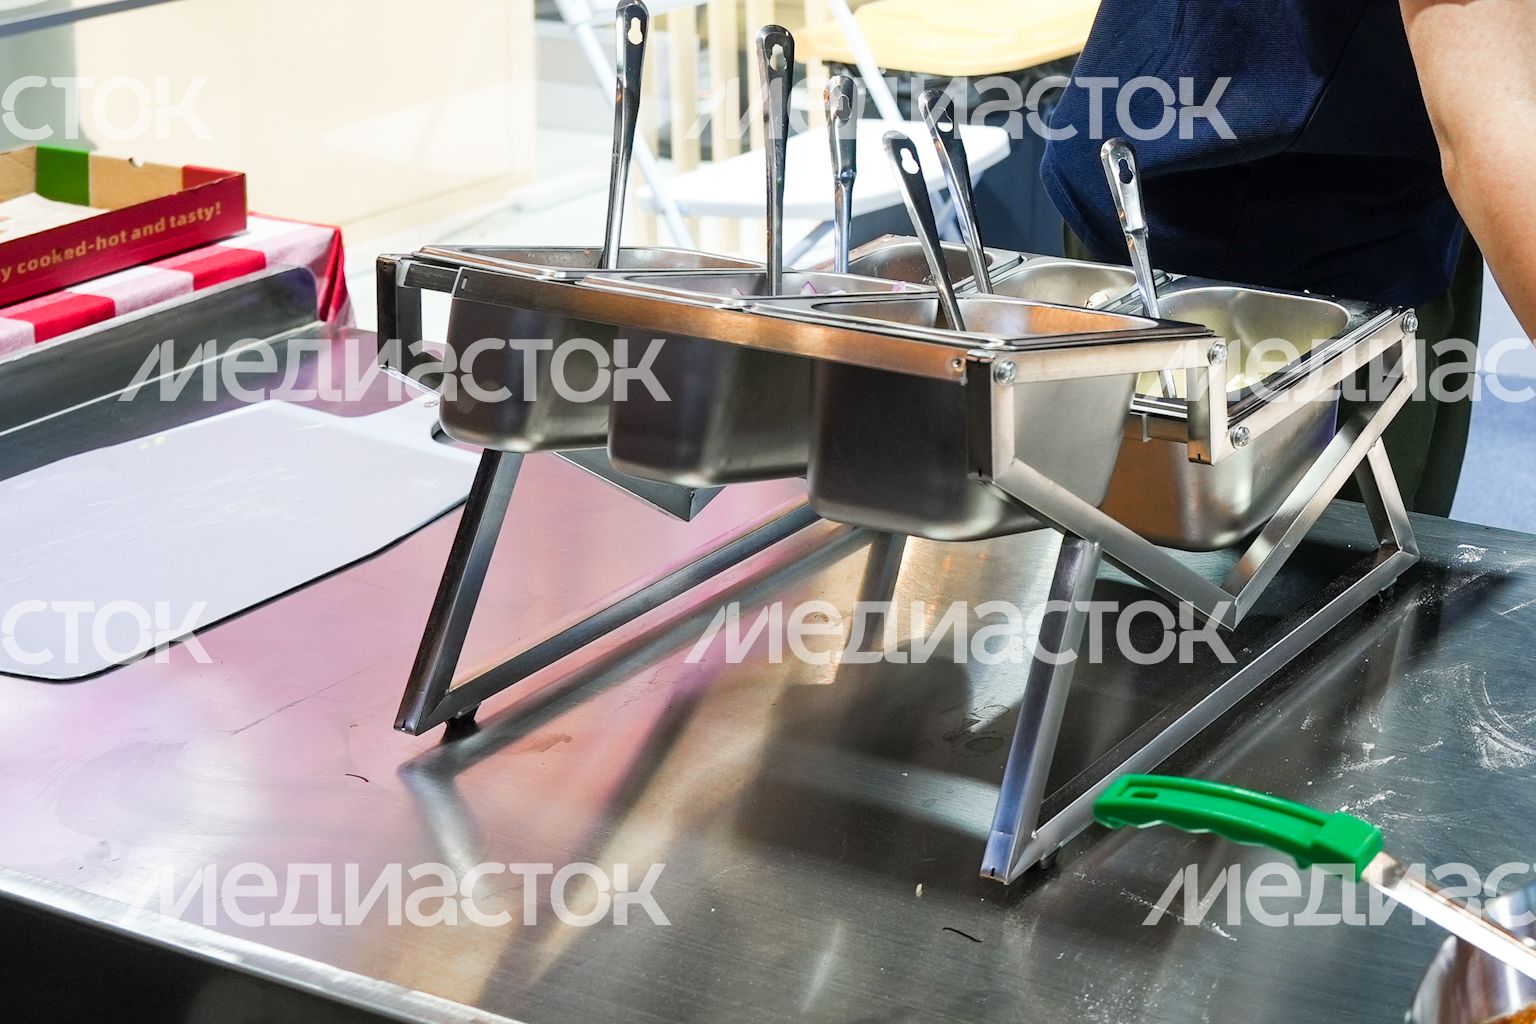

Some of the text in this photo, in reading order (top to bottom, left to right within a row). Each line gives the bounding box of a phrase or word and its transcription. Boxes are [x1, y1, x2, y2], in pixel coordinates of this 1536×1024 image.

[17, 230, 128, 275] cooked-hot
[131, 217, 166, 241] and
[169, 201, 221, 230] tasty!
